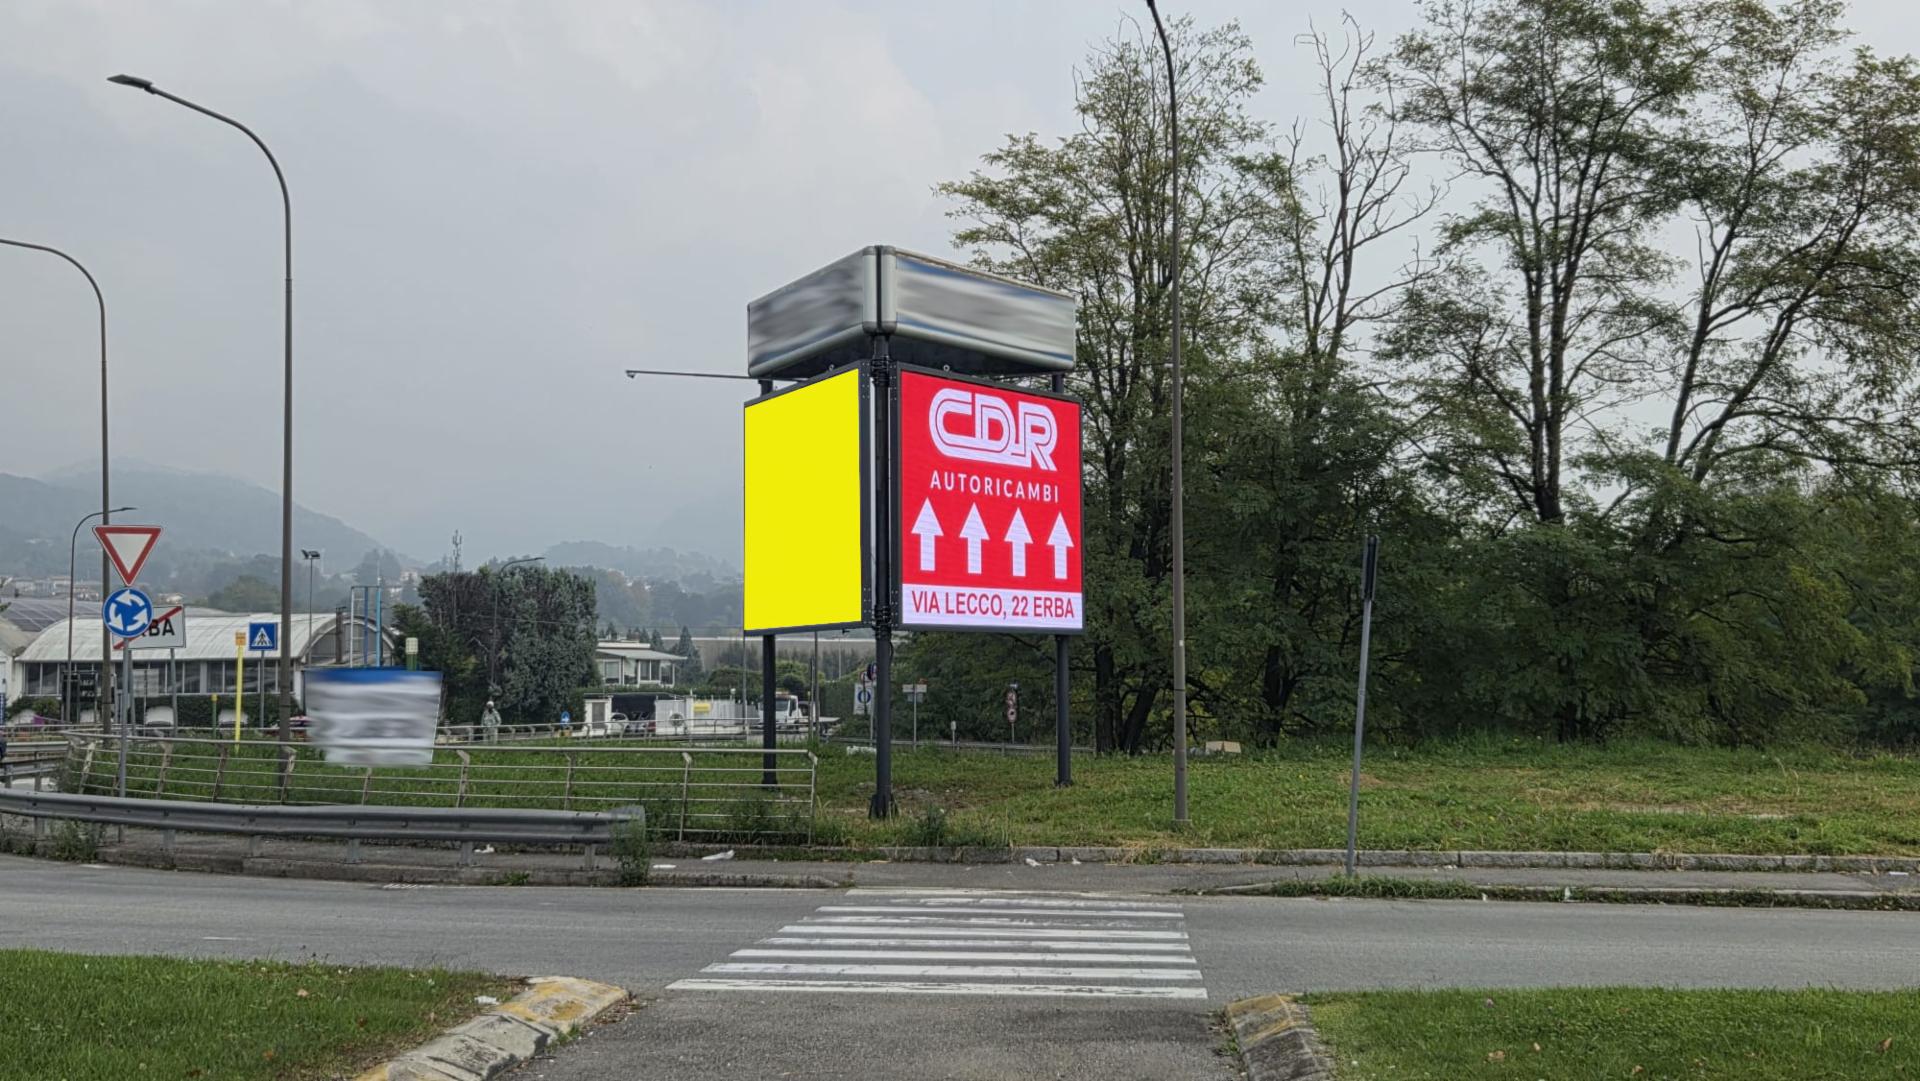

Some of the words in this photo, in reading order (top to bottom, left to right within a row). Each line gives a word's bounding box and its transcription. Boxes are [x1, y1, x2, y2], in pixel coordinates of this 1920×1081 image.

[929, 388, 1057, 471] CDR
[930, 470, 1058, 503] AUTORICAMBI
[912, 590, 940, 614] VIA
[945, 592, 1007, 619] LECCO,
[1012, 595, 1028, 617] 22
[1033, 596, 1075, 618] ERBA
[142, 618, 175, 637] BA
